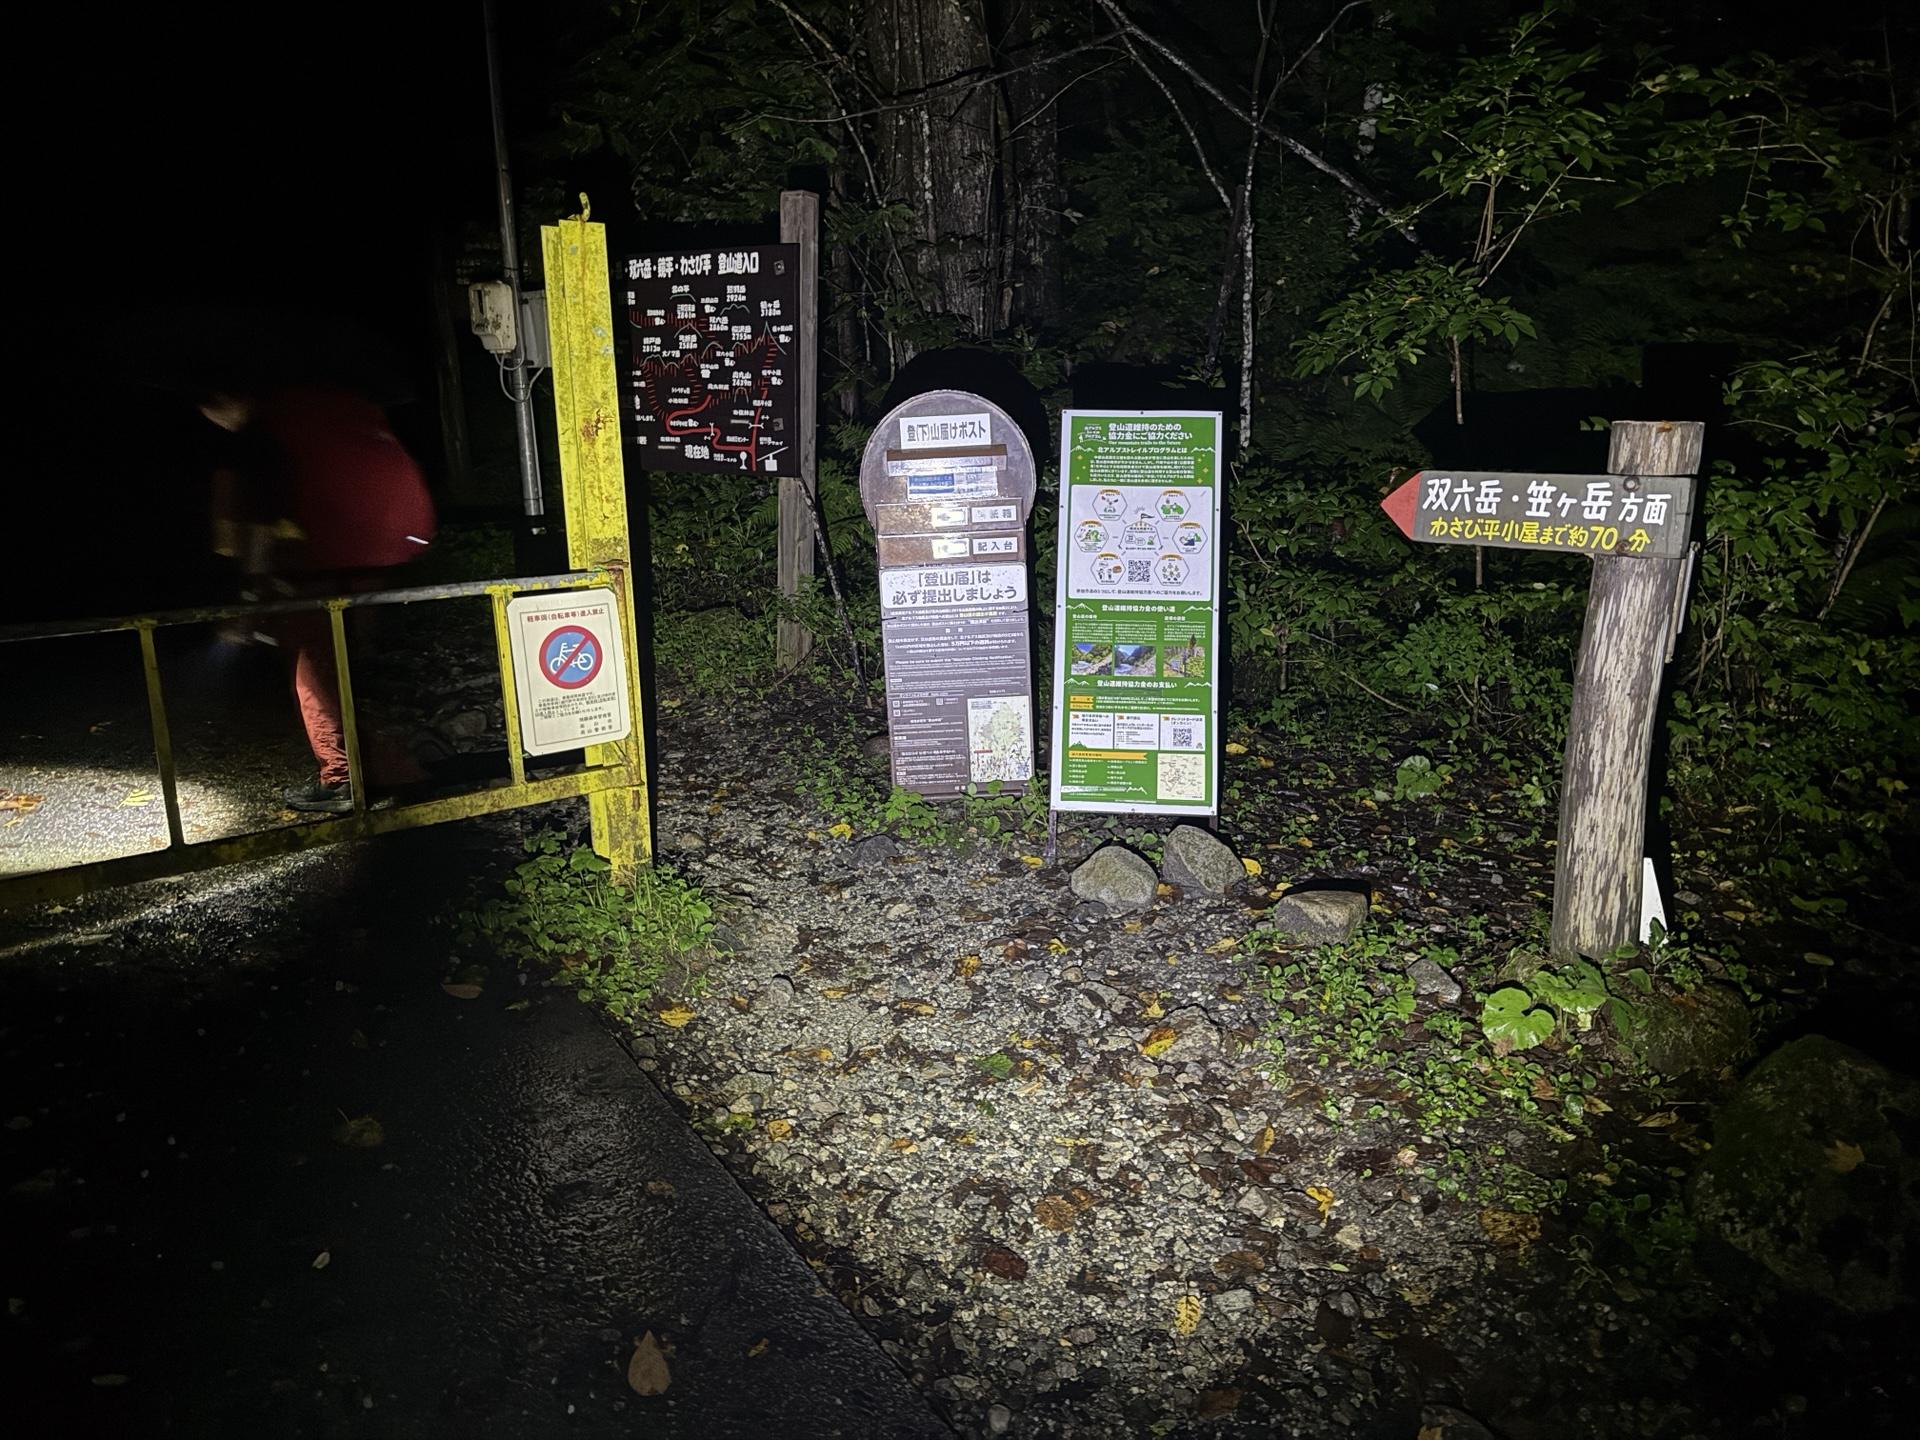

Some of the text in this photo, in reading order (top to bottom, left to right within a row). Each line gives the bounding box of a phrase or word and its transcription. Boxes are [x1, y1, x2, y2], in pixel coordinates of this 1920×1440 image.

[717, 251, 760, 275] 登山道入口
[906, 421, 987, 443] 登(下)山届けポスト
[1108, 422, 1182, 432] 登山道維持のための
[1108, 431, 1193, 441] 協力金にご協力ください
[684, 444, 710, 459] 現在地
[977, 540, 1013, 552] 記入台
[918, 571, 992, 588] 「登山届」は
[892, 586, 1017, 606] 必ず提出しましょう
